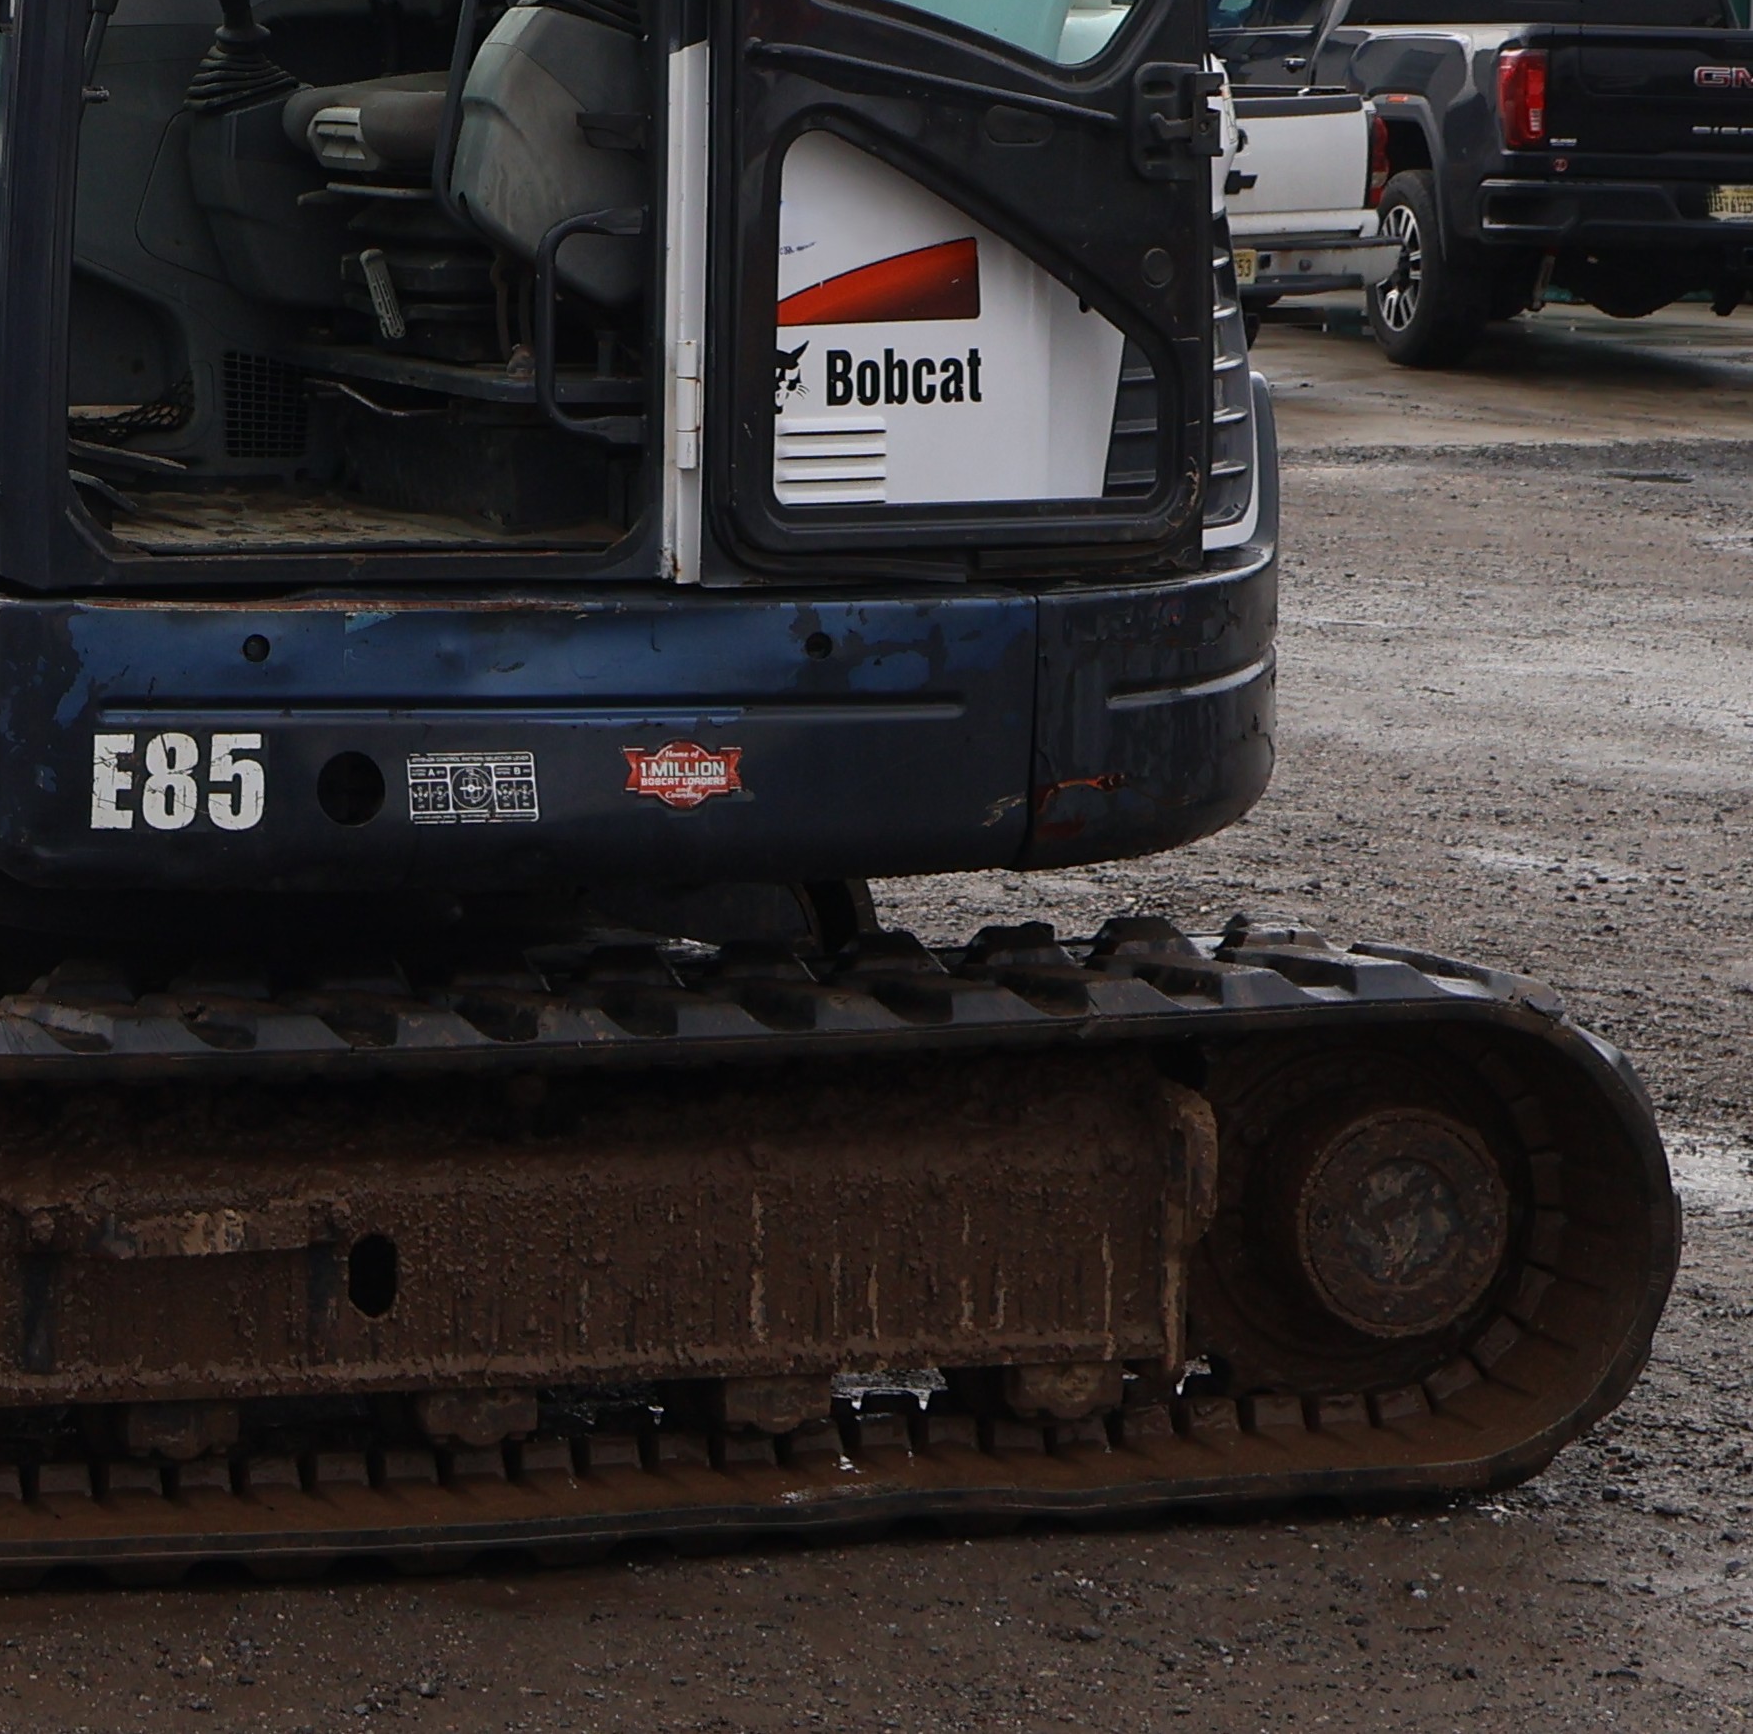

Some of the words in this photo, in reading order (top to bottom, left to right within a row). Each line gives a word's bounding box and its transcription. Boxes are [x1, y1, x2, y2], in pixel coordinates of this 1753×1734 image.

[826, 348, 982, 407] Bobcat
[665, 750, 689, 758] Home
[690, 750, 700, 759] of
[640, 761, 647, 777] 1
[651, 761, 725, 777] MILLION
[90, 733, 264, 830] E85
[641, 777, 679, 786] BOBCAT
[682, 777, 727, 786] LOADERS
